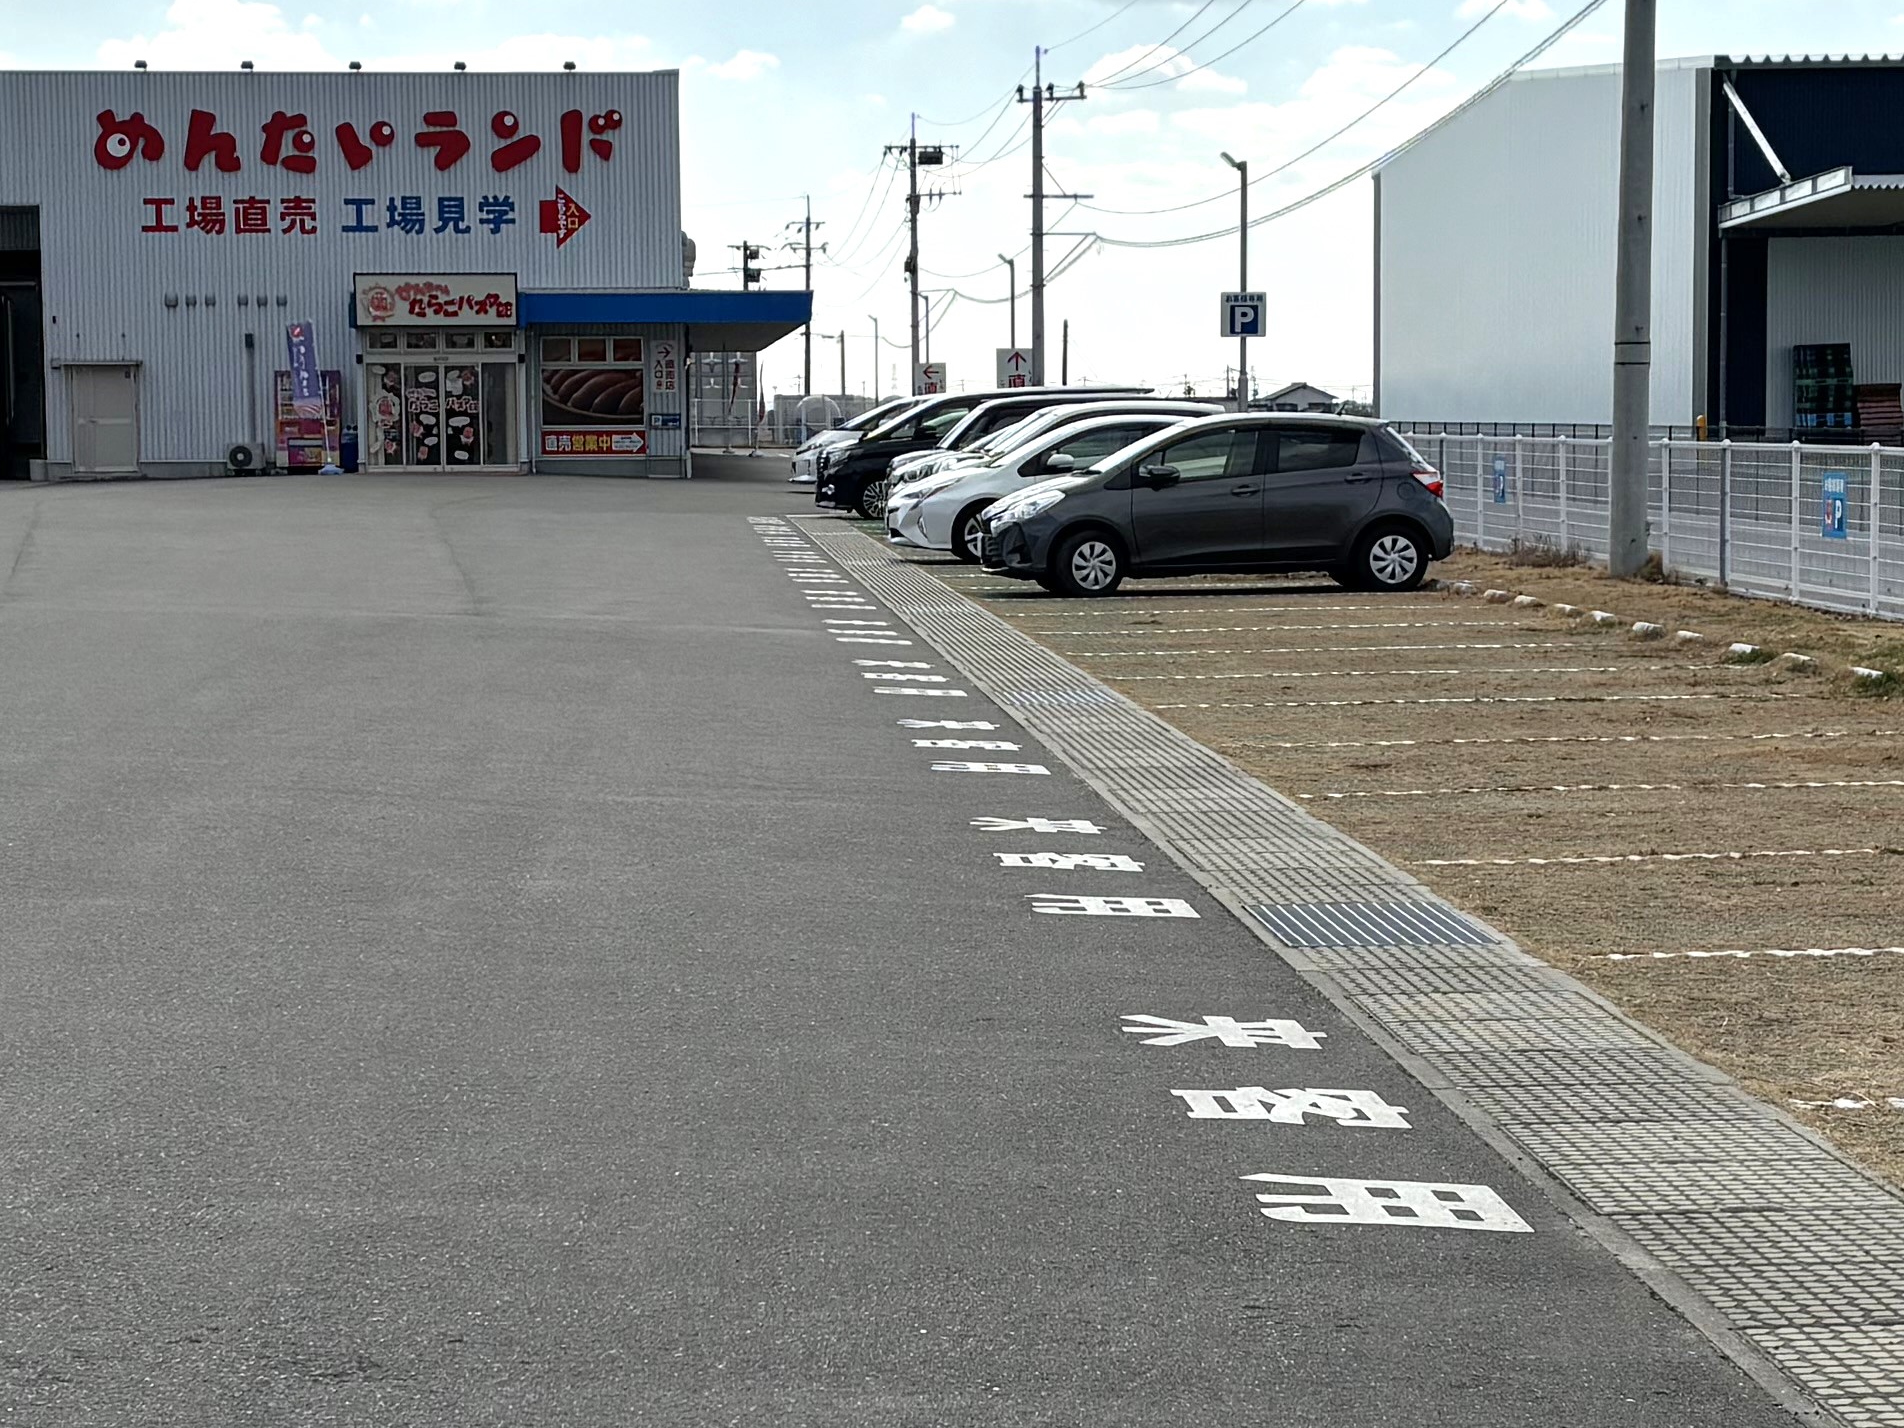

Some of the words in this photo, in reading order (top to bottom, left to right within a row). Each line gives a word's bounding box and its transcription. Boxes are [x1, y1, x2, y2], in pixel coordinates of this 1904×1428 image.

[94, 109, 623, 173] めんたいランド
[141, 195, 317, 235] 工場直売
[341, 195, 517, 235] 工場見学
[567, 203, 579, 229] 入口
[1234, 306, 1255, 333] P
[545, 434, 611, 451] 直売営業中
